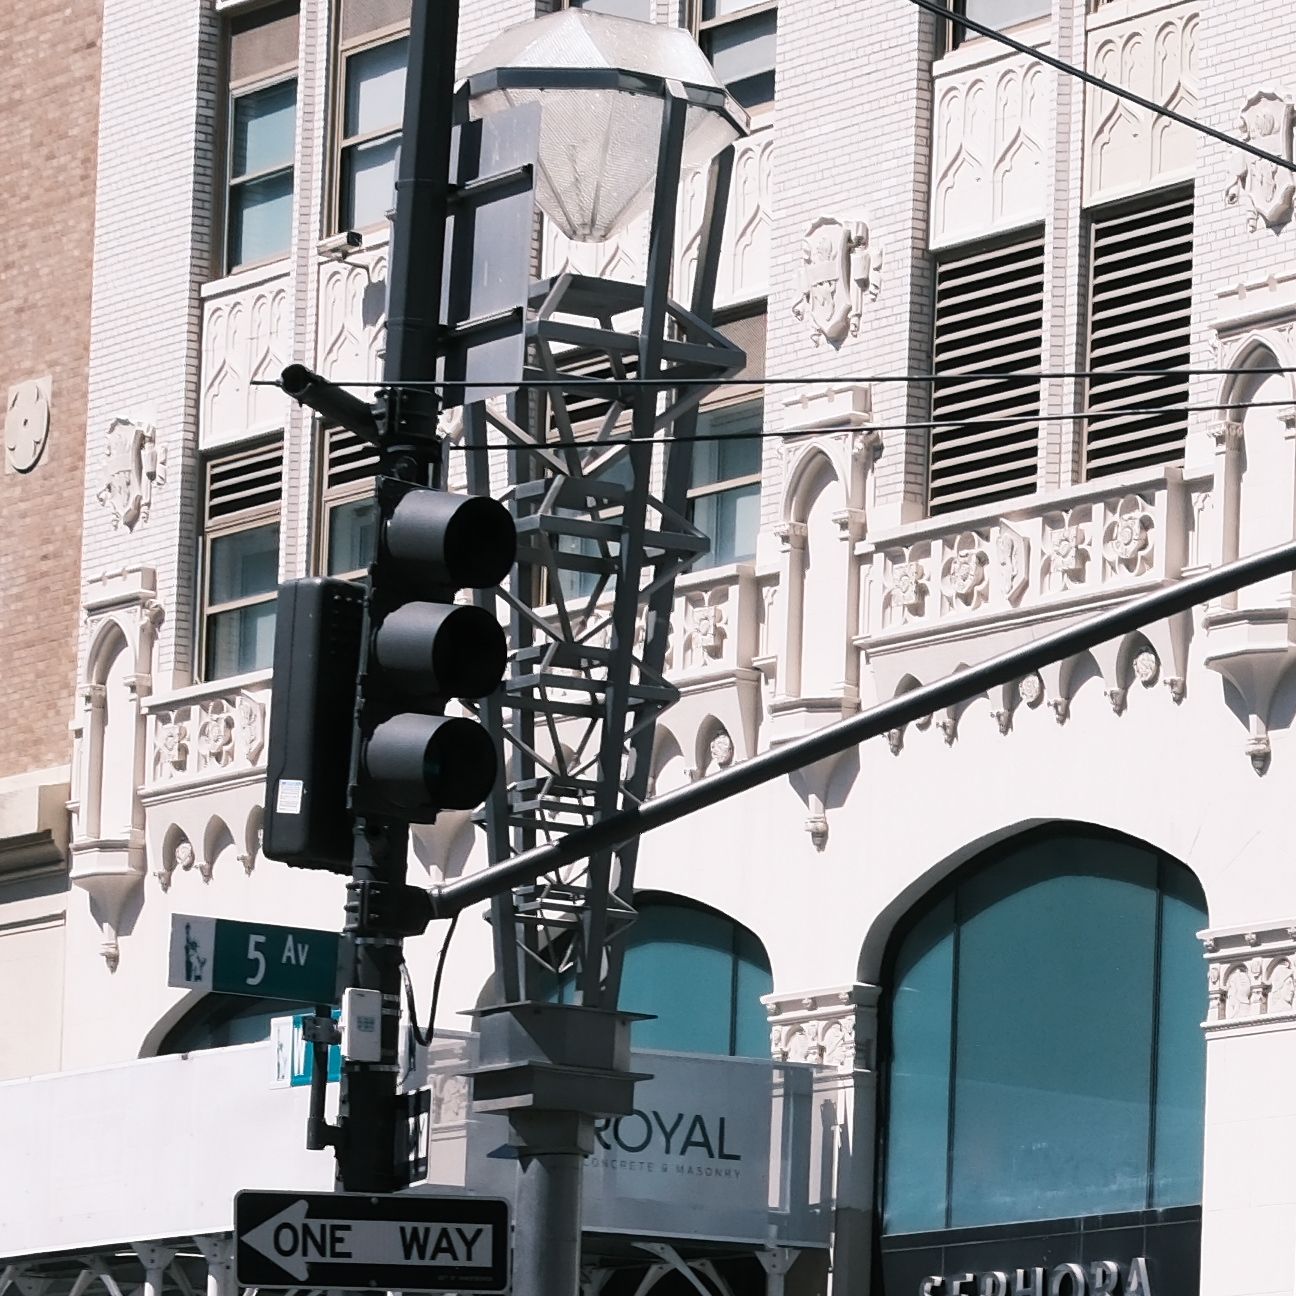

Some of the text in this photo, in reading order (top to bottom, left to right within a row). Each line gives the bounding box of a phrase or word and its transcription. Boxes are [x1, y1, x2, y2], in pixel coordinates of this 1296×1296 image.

[245, 934, 309, 986] 5 Av
[676, 1165, 741, 1180] MASONRY
[273, 1222, 483, 1262] ONE WAY
